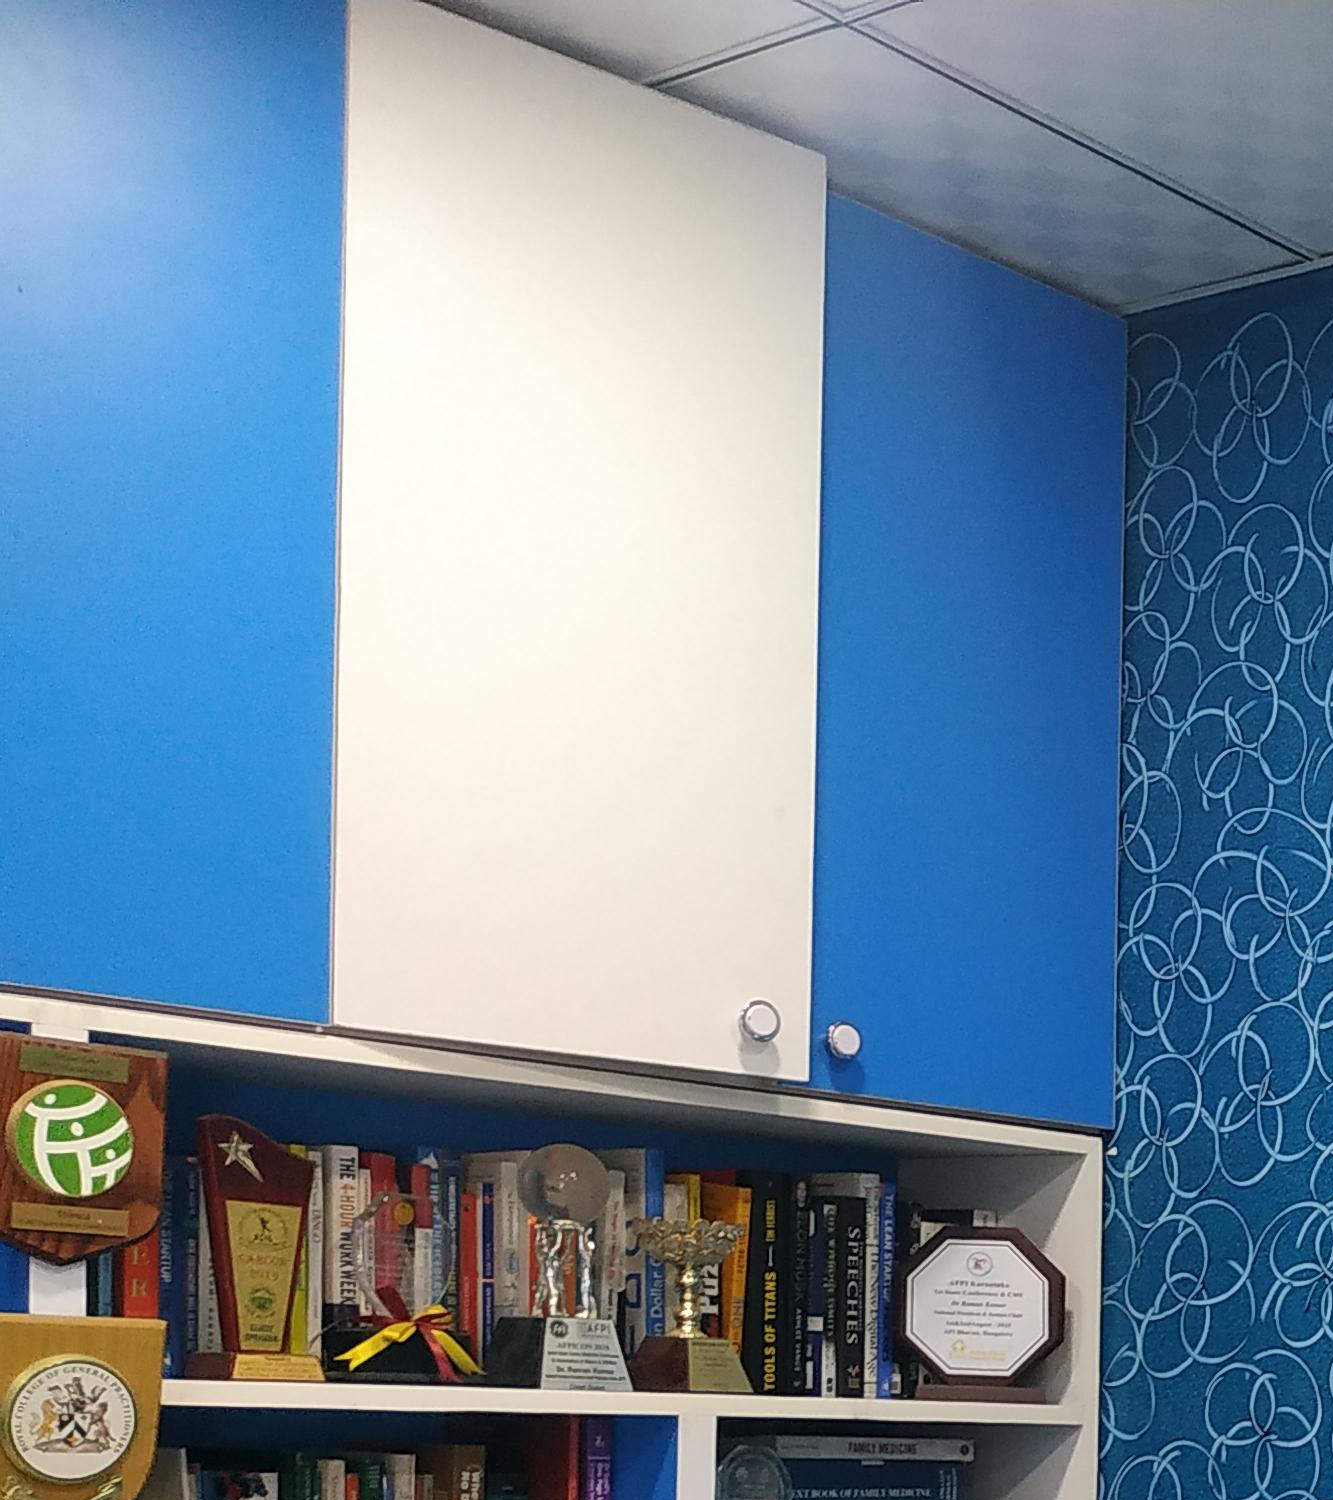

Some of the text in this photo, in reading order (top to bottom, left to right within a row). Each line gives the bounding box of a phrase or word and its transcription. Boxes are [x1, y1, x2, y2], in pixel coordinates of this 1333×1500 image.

[339, 1156, 356, 1180] THE
[340, 1182, 357, 1227] 4-HOUR
[161, 1230, 173, 1284] STARTUP
[884, 1194, 894, 1303] THE LEAN STARTUP
[650, 1271, 663, 1318] Dollar
[764, 1271, 776, 1321] TITANS
[846, 1226, 860, 1345] SPEECHES
[764, 1326, 776, 1343] OF
[764, 1346, 776, 1391] TOOLS
[15, 1378, 45, 1420] COLLEGE
[63, 1366, 112, 1382] GENERAL
[109, 1381, 132, 1453] PRACTITIONERS
[849, 1443, 917, 1455] FAMILY MEDICINE
[459, 1471, 469, 1490] No
[852, 1488, 887, 1498] FAMILY
[888, 1488, 932, 1498] MEDICINE
